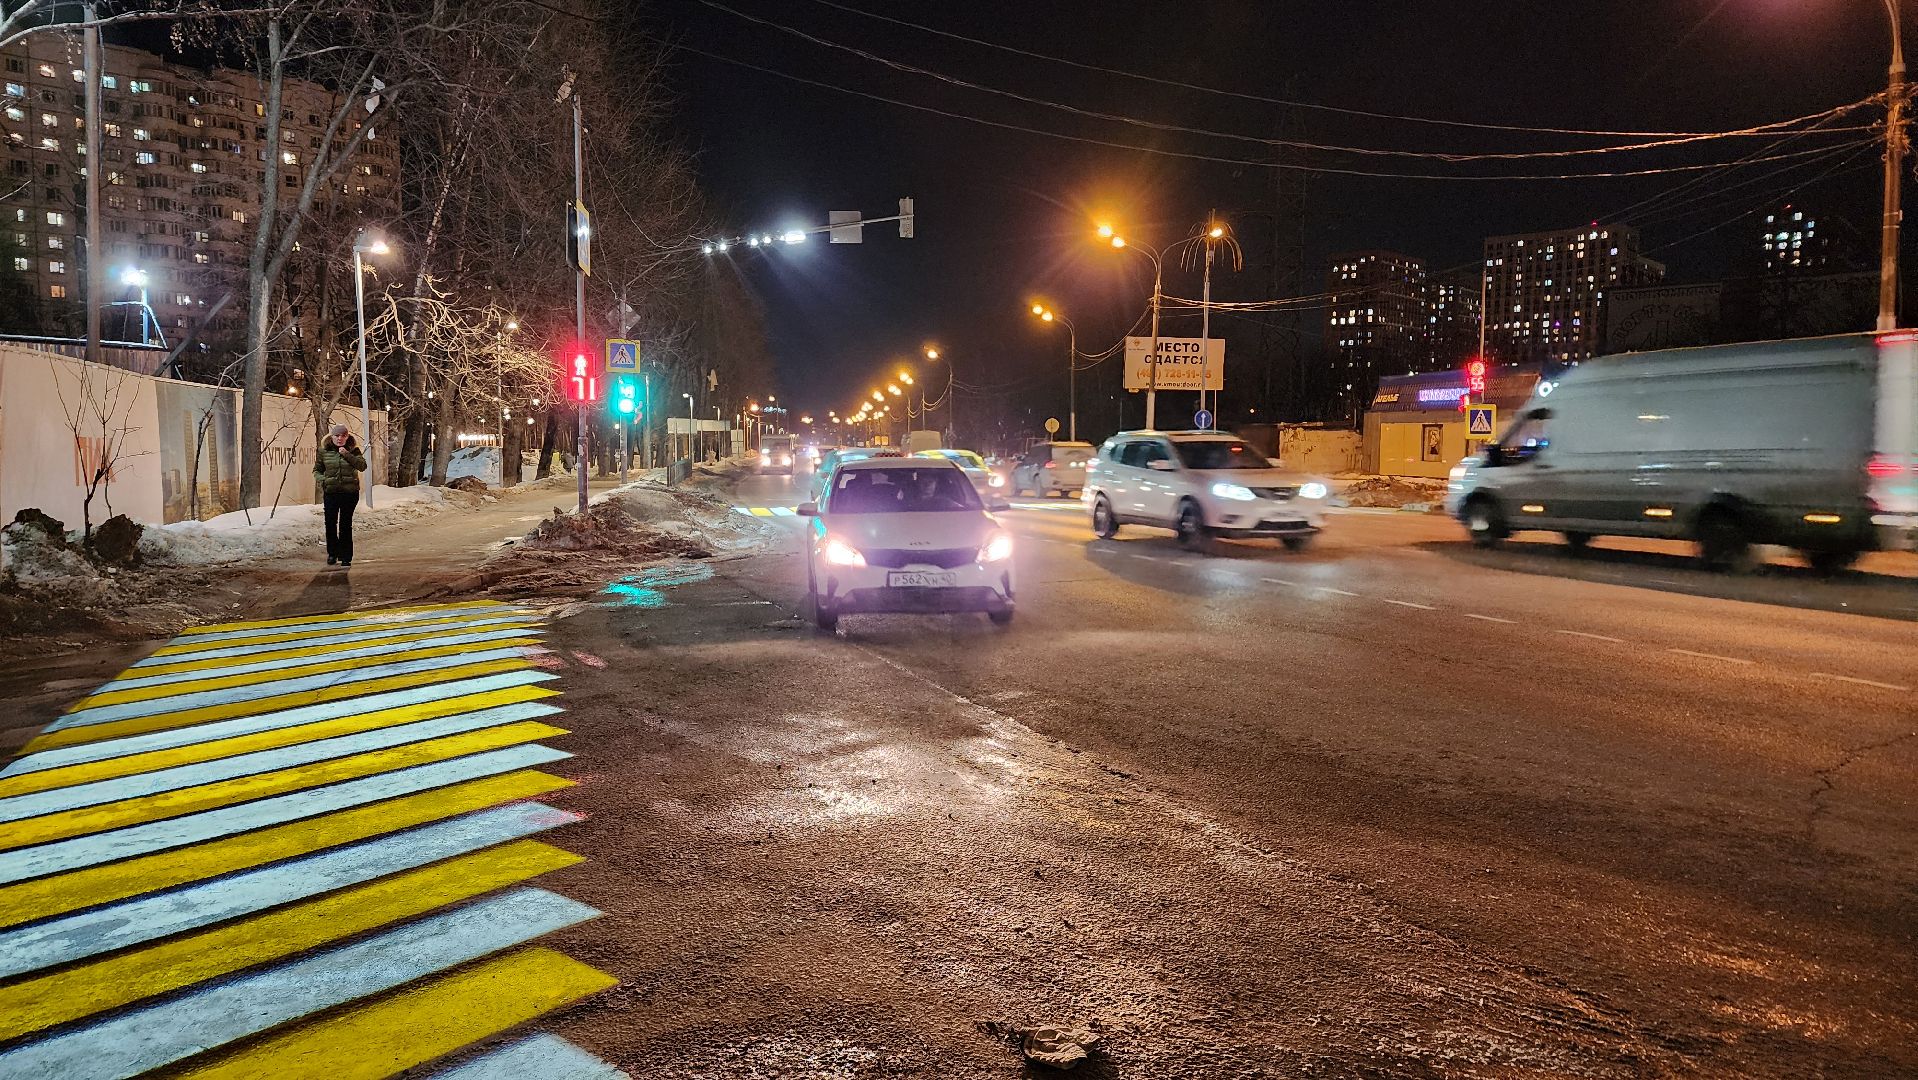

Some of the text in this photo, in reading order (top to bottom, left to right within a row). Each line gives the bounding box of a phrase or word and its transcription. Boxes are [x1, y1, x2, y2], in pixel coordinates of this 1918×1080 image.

[1156, 342, 1200, 352] МЕСТО
[571, 376, 596, 400] 71
[1471, 377, 1484, 390] 55
[261, 440, 297, 471] Купите
